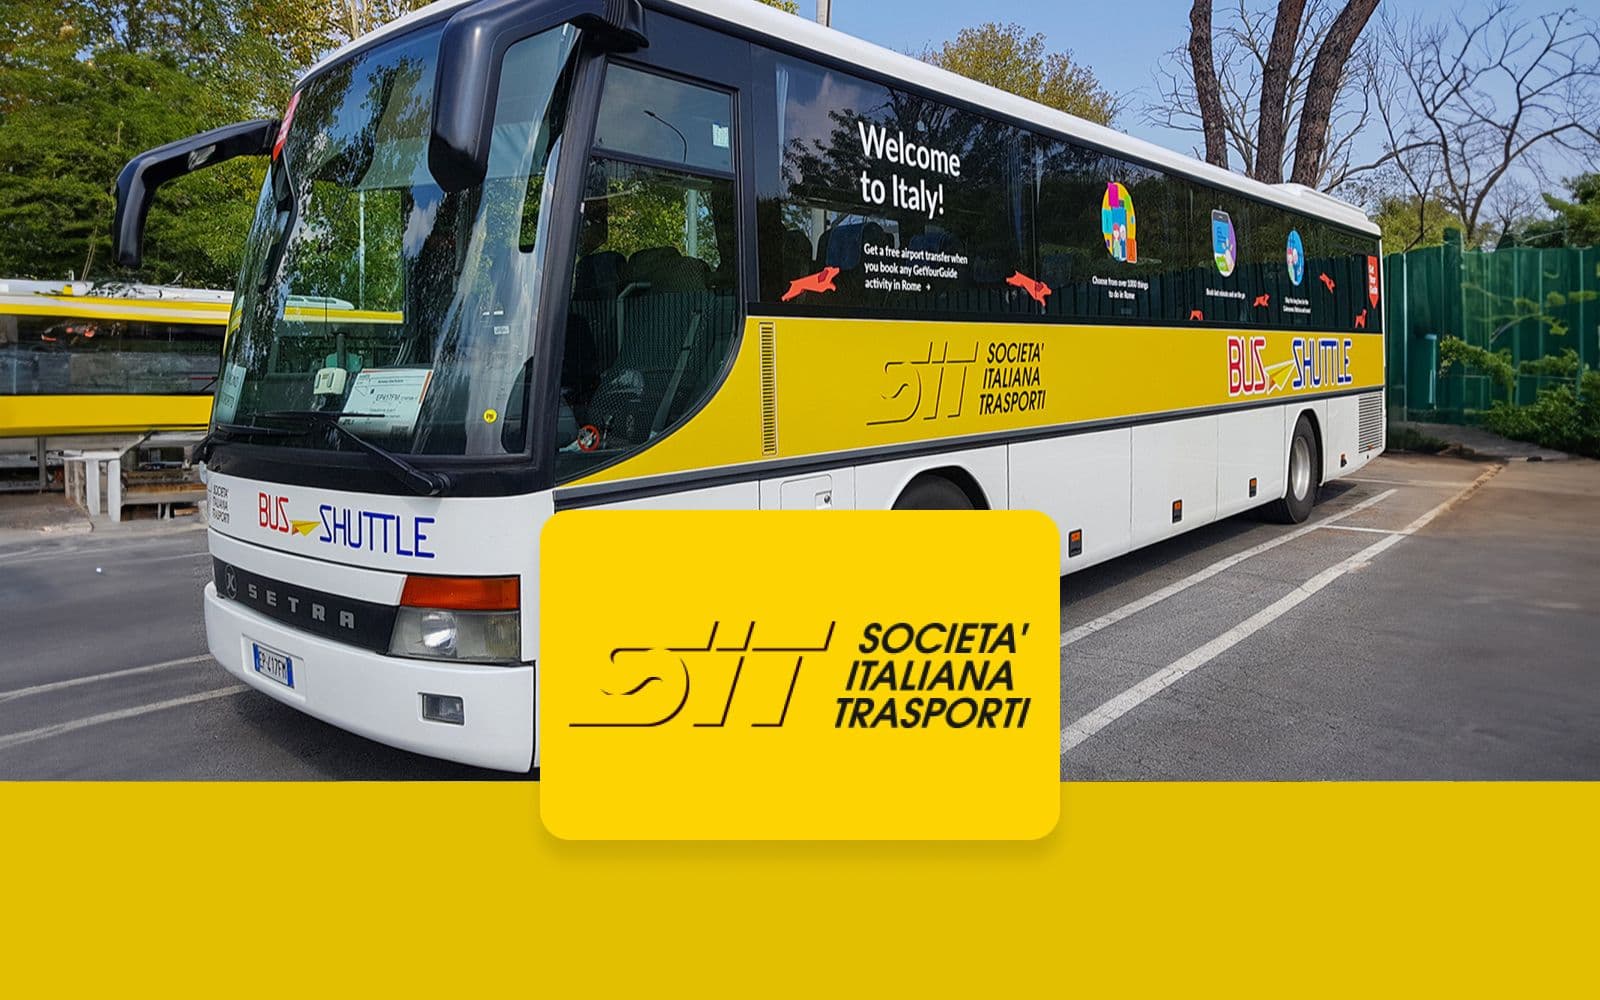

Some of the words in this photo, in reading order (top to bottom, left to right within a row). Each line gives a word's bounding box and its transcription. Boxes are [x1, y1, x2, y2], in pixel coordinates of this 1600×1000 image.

[858, 120, 960, 177] Welcome
[860, 170, 886, 205] to
[892, 174, 944, 220] Italy!
[863, 242, 878, 256] Get
[879, 247, 884, 256] a
[885, 245, 900, 258] free
[901, 247, 924, 261] airport
[925, 250, 950, 263] transfer
[951, 253, 968, 265] when
[864, 262, 879, 274] you
[880, 261, 899, 274] book
[899, 265, 912, 277] any
[913, 264, 958, 279] GetYourGuide
[864, 277, 892, 292] activity
[893, 278, 900, 290] in
[901, 279, 922, 292] Rome
[986, 342, 1045, 364] SOCIETA'
[1227, 336, 1267, 397] BUS
[1292, 337, 1353, 390] SHUTTLE
[983, 366, 1041, 389] ITALIANA
[979, 389, 1047, 416] TRASPORTI
[258, 491, 290, 534] BUS
[318, 503, 436, 559] SHUTTLE
[248, 583, 355, 630] SETRA
